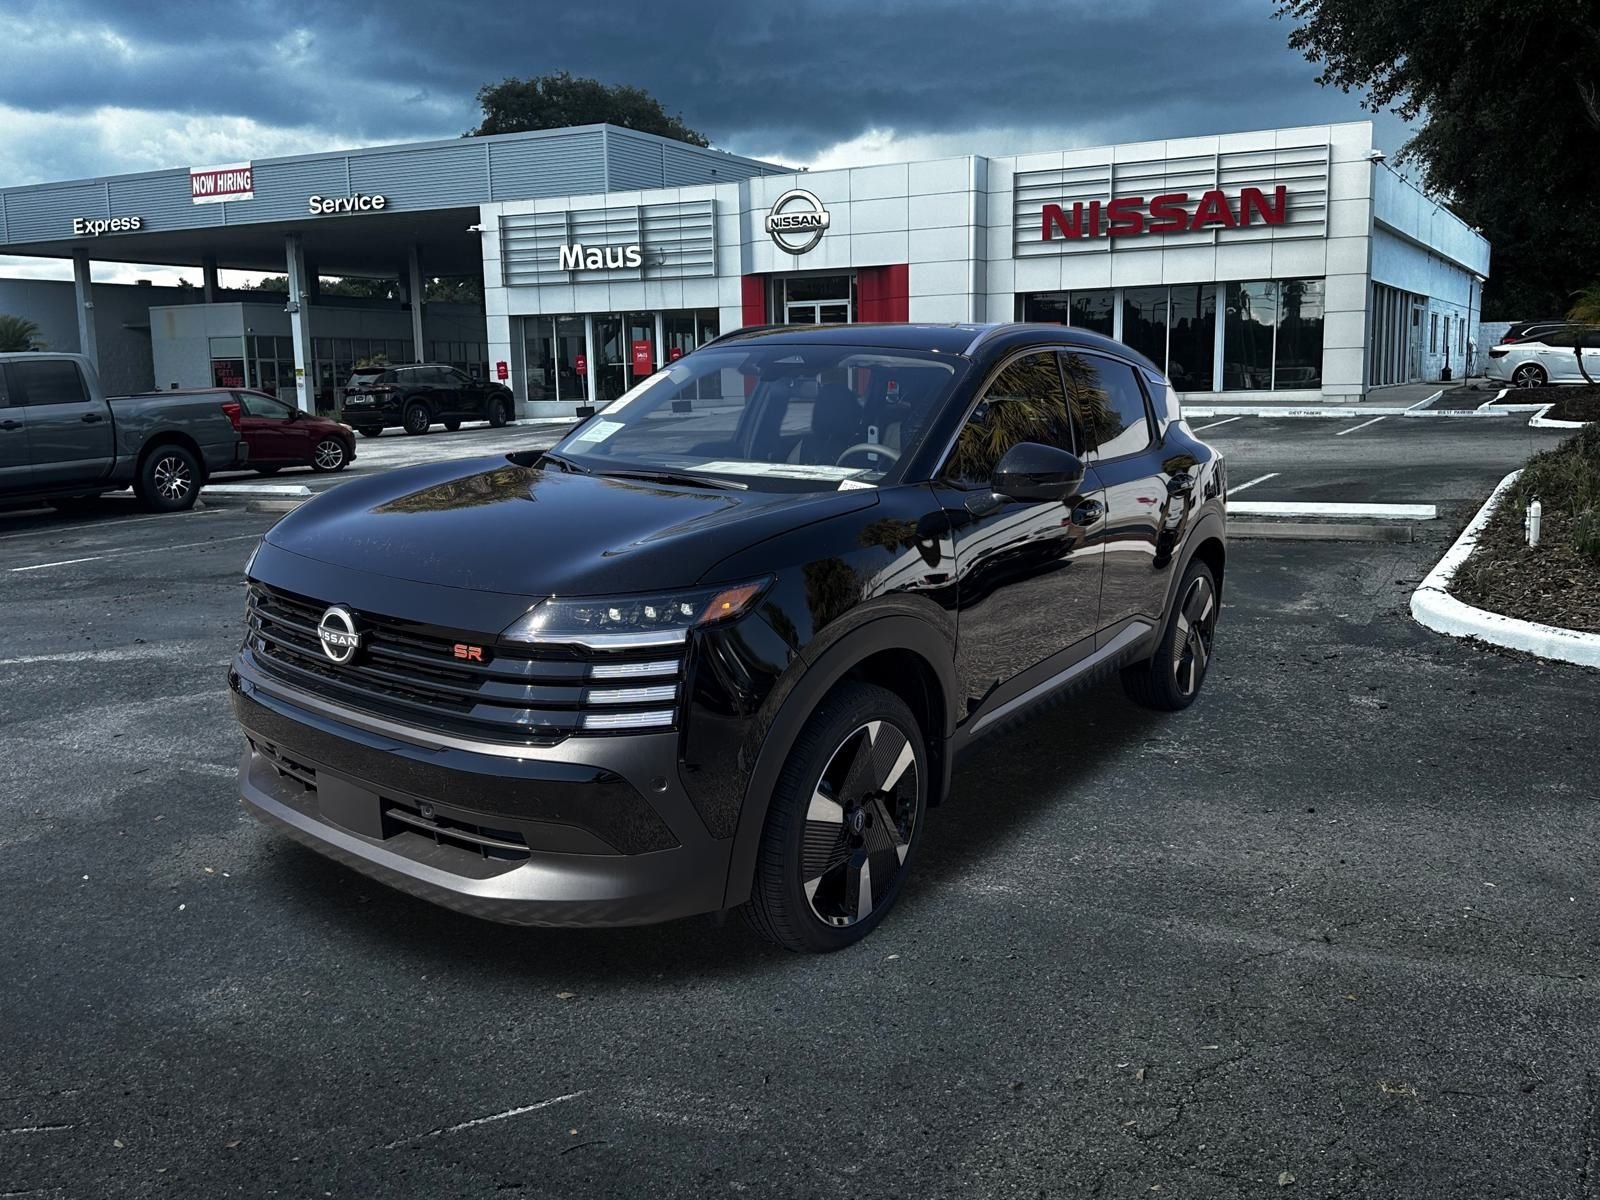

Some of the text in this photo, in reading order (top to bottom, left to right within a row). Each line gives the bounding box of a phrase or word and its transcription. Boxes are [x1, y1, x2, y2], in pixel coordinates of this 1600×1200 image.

[193, 171, 251, 195] NOW HIRING
[309, 193, 385, 215] Service
[1042, 185, 1287, 241] NISSAN
[73, 216, 141, 237] Express
[770, 214, 822, 228] NISSAN
[559, 243, 642, 271] Maus
[454, 643, 482, 662] SR
